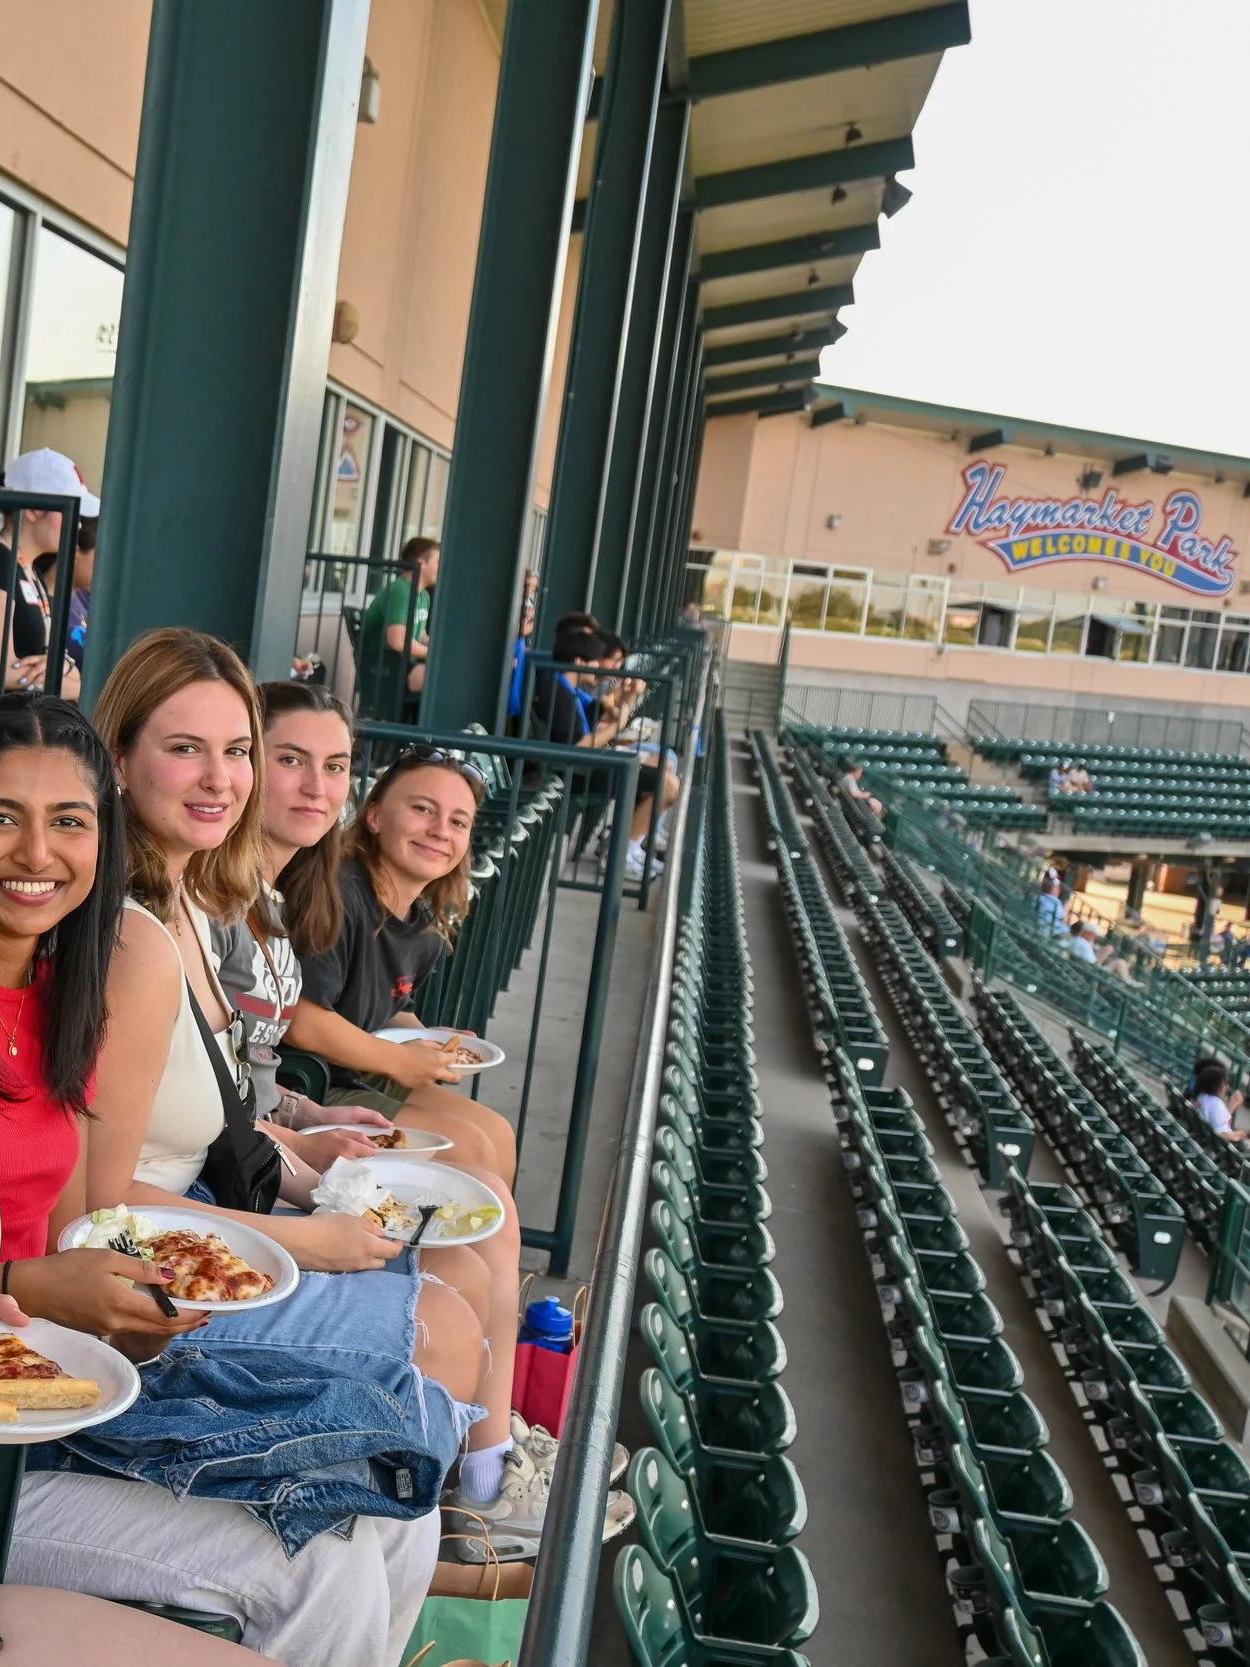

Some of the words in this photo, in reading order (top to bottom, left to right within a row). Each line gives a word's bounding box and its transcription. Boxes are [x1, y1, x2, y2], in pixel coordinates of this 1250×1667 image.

[949, 461, 1155, 539] Haymarket
[1156, 490, 1234, 578] Park
[1011, 533, 1132, 561] WELCOMES
[1139, 546, 1178, 578] YOU
